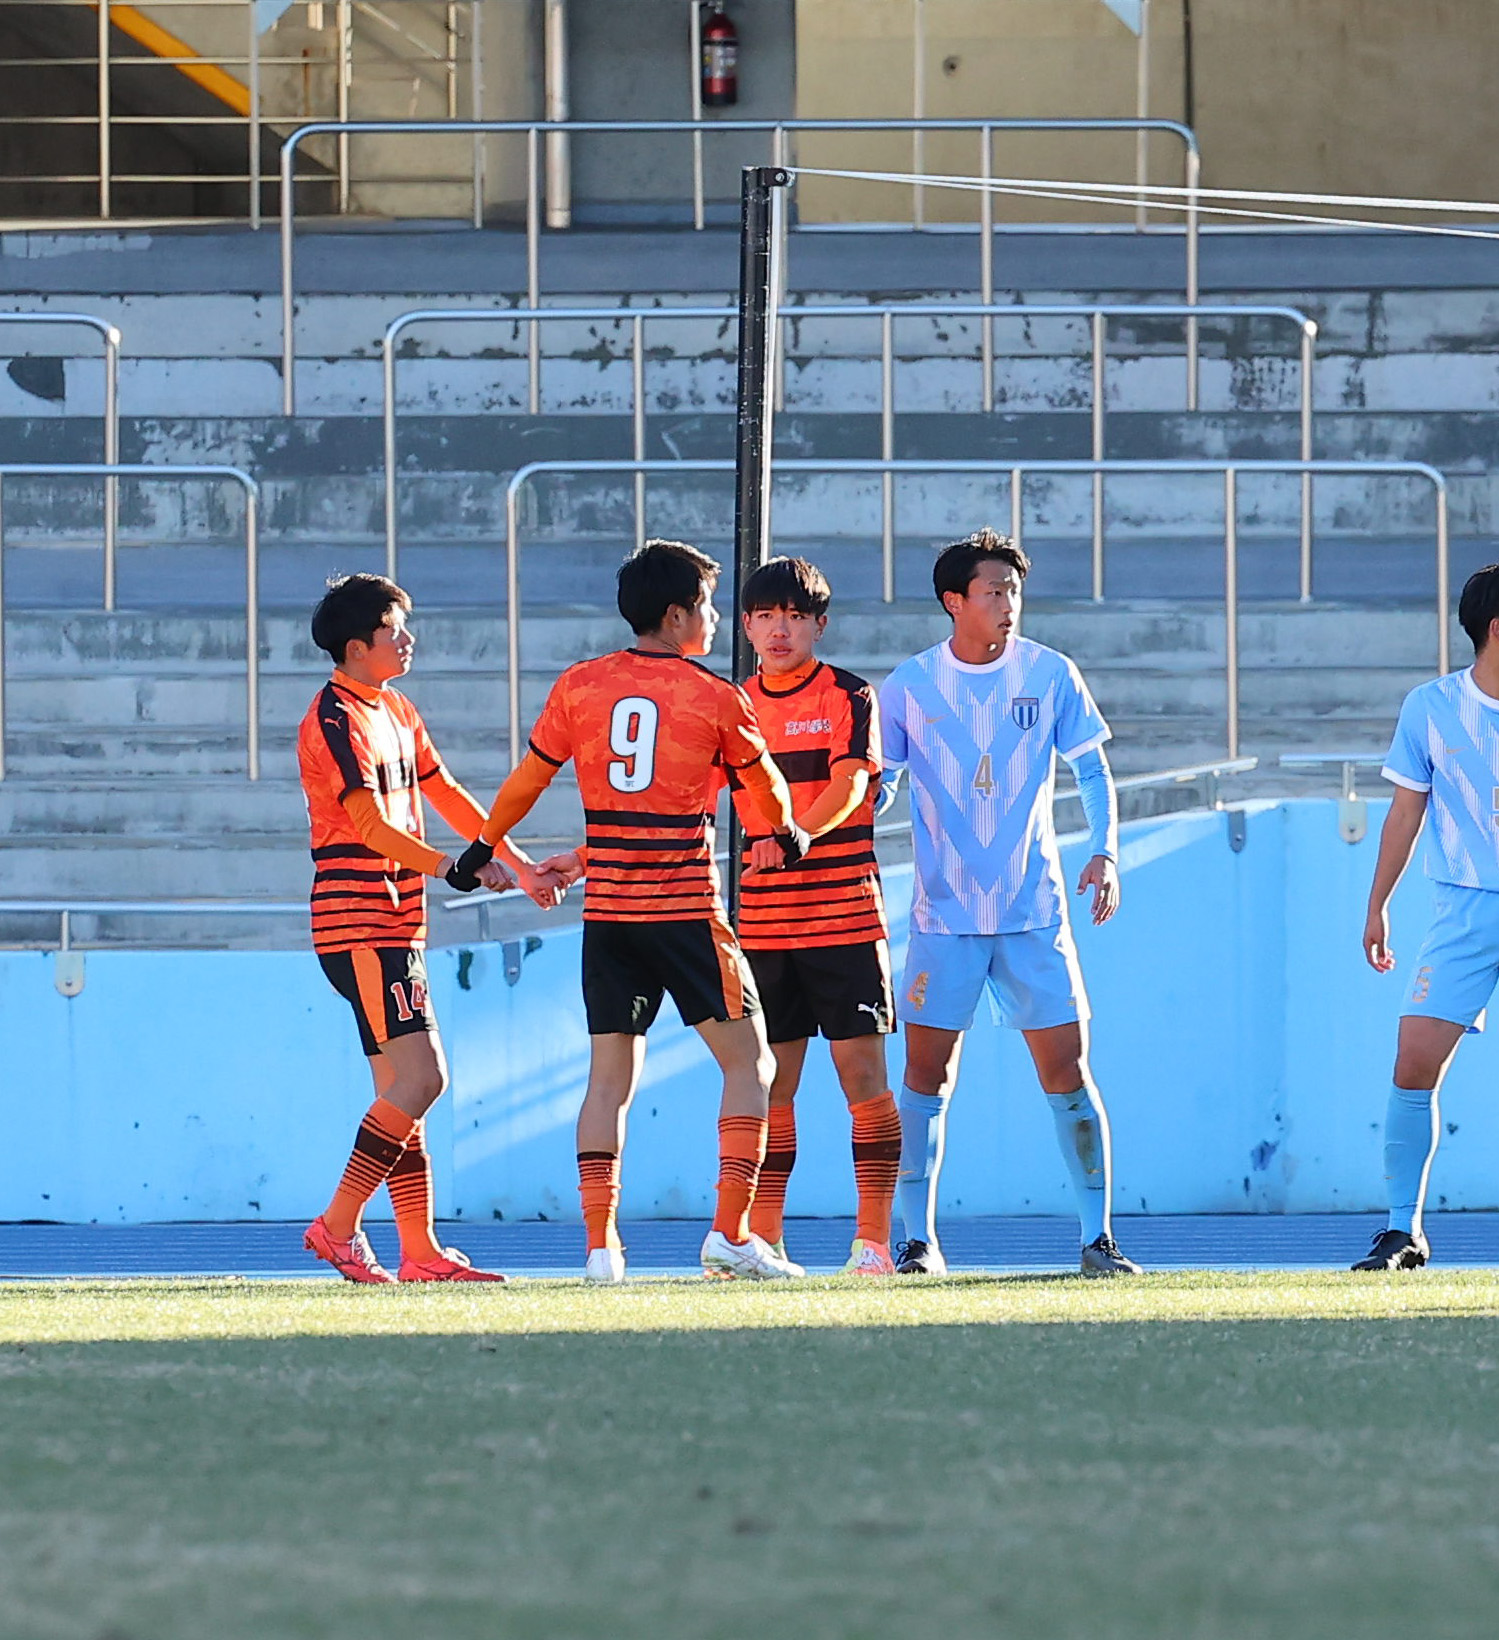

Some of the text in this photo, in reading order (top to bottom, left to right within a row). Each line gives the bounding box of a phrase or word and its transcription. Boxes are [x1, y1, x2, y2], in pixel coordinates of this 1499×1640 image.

[608, 696, 660, 794] 9
[973, 753, 994, 797] 4
[391, 980, 427, 1021] 14
[907, 972, 930, 1011] 4
[1412, 966, 1433, 1003] 5
